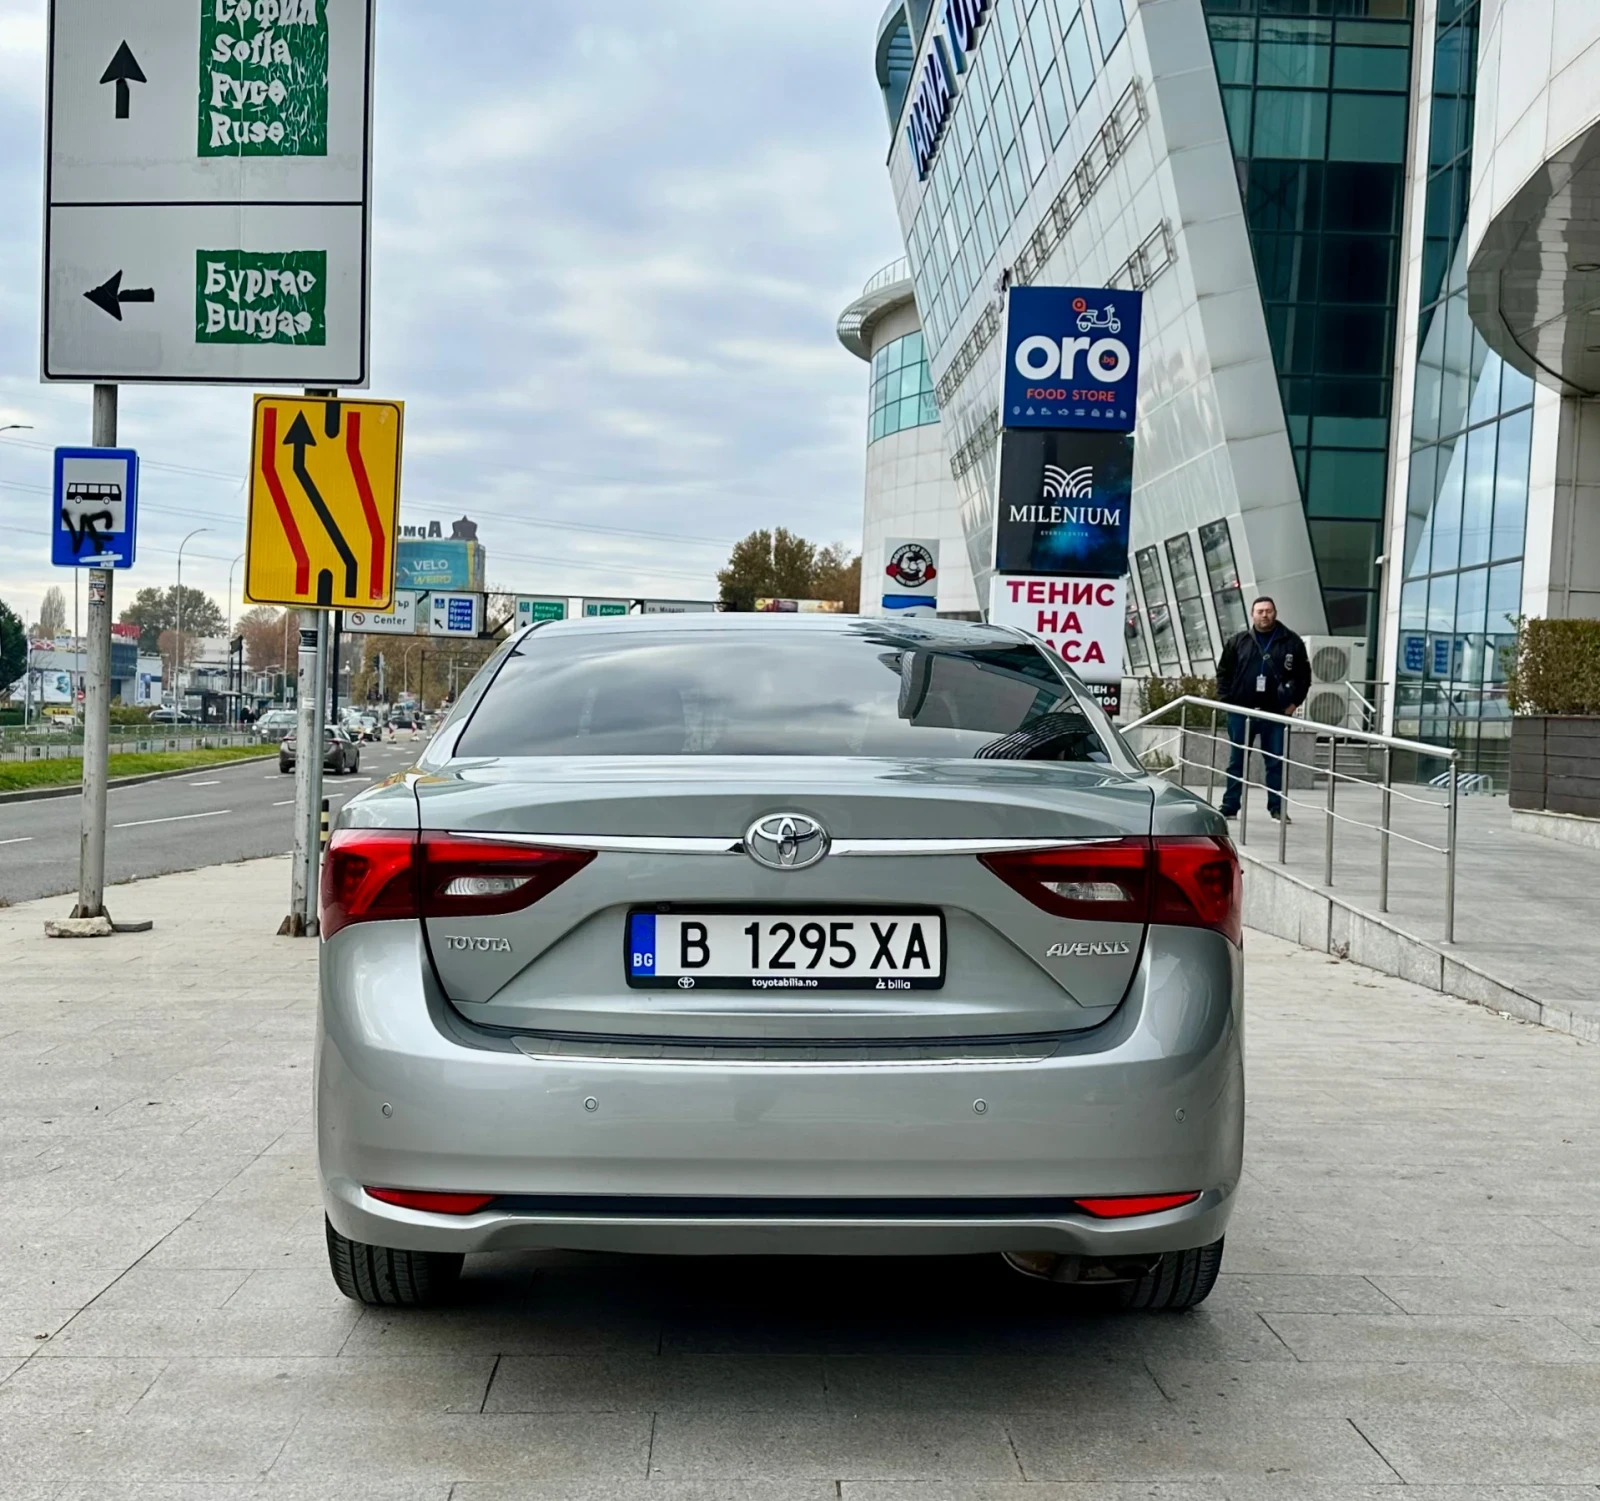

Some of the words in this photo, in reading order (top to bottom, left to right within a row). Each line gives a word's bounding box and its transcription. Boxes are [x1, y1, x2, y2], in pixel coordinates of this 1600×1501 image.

[211, 28, 292, 69] Sofia
[210, 71, 288, 110] Русе
[209, 110, 286, 148] Ruse
[204, 261, 317, 304] Бургас
[205, 300, 313, 339] Burgas
[1015, 335, 1131, 383] oro
[1026, 388, 1067, 400] FOOD
[1072, 389, 1116, 403] STORE
[1009, 504, 1121, 526] MILENIUM
[413, 559, 449, 571] VELO
[1006, 580, 1116, 607] ТЕНИС
[373, 614, 407, 626] Center
[1037, 610, 1083, 634] НА
[444, 935, 513, 952] TOYOTA
[681, 921, 710, 969] B
[744, 922, 857, 970] 1295
[869, 922, 931, 970] XA
[1045, 940, 1132, 957] AVENSIS
[632, 952, 654, 968] BG
[751, 977, 819, 990] toyotabilia.no
[887, 979, 912, 990] bilia
